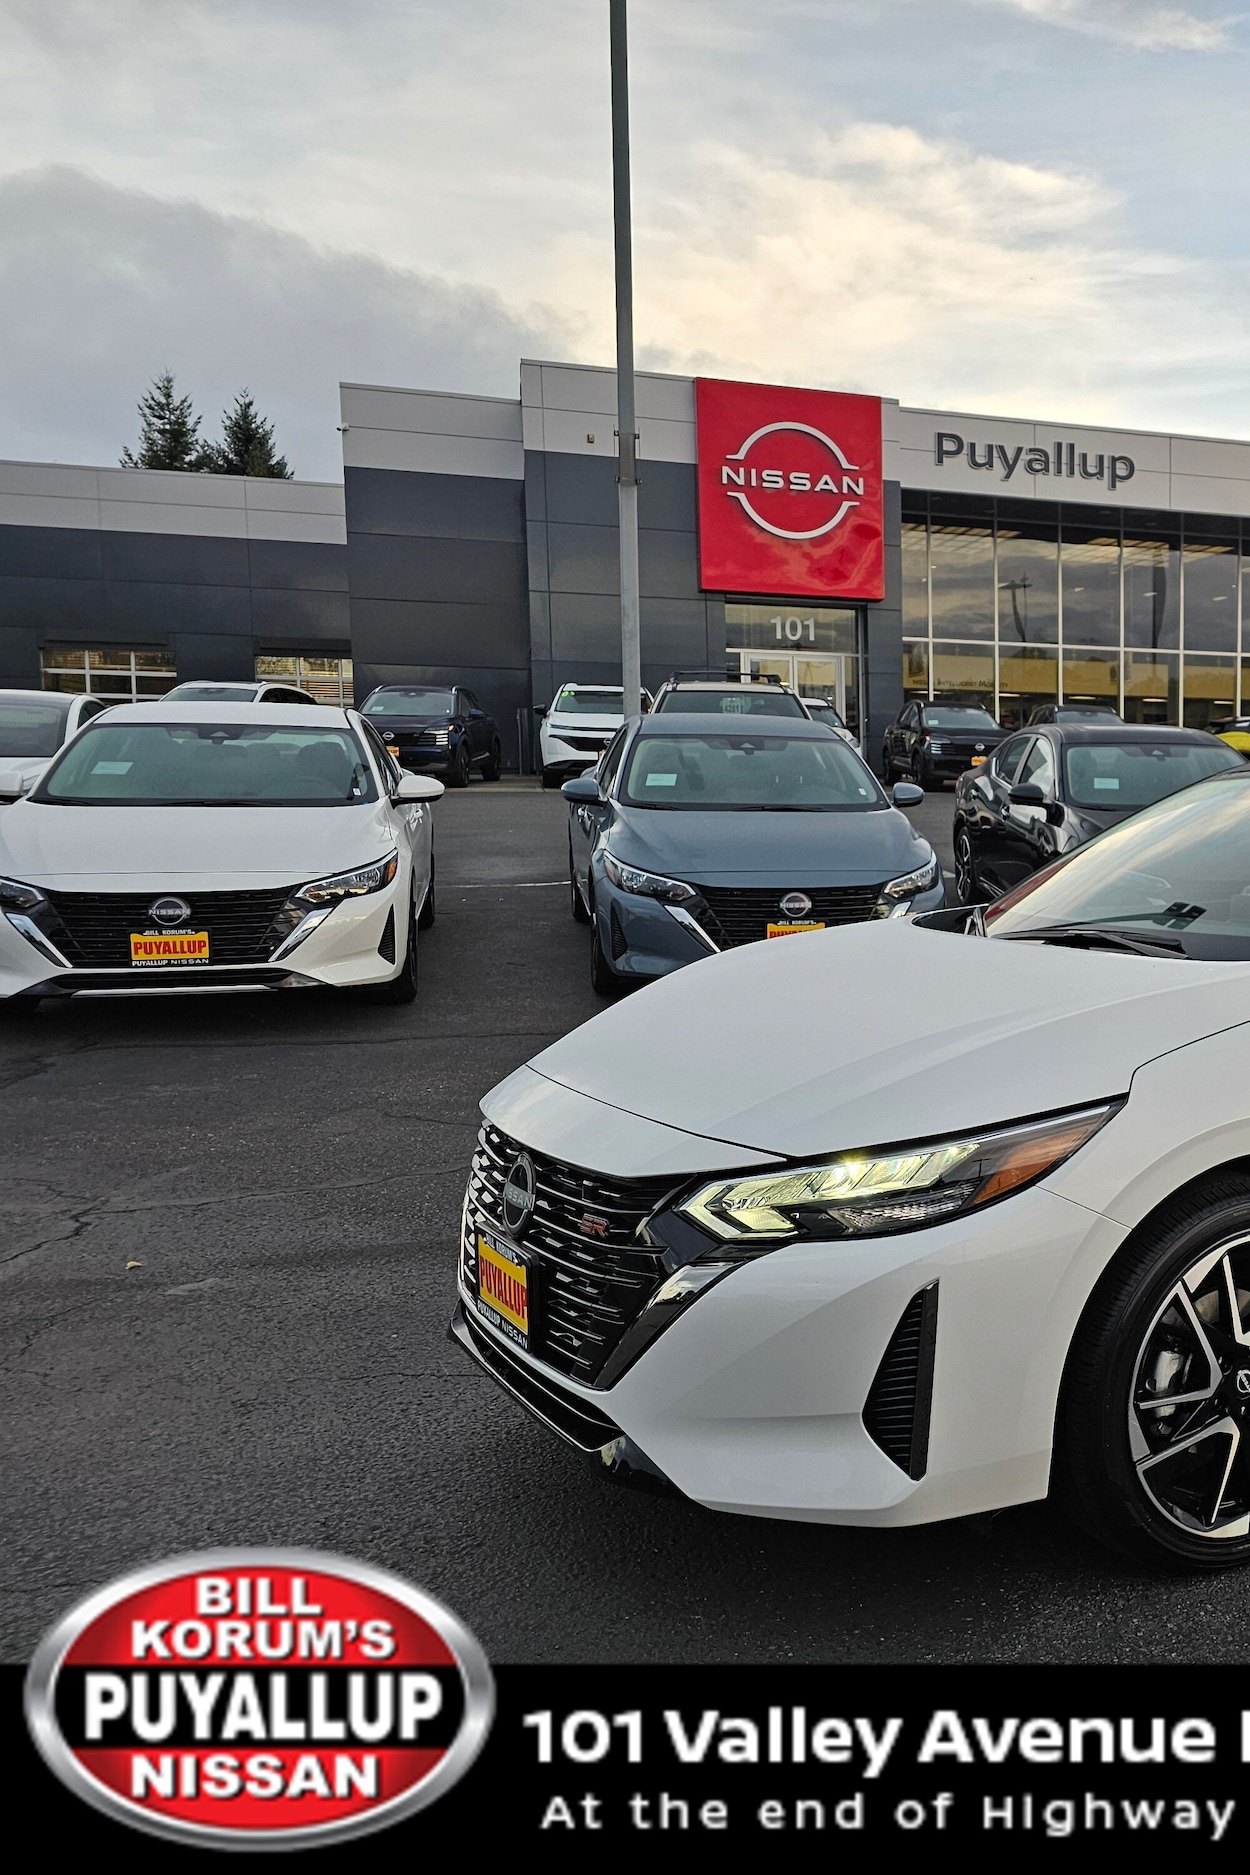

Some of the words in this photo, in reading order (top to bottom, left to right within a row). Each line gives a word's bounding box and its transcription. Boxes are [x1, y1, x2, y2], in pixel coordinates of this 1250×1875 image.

[935, 431, 1136, 491] Puyallup
[721, 465, 865, 496] NISSAN
[770, 615, 815, 641] 101
[148, 908, 191, 916] NISSAN
[133, 940, 207, 956] PUYALLUP
[131, 959, 168, 967] PUYALLUP
[580, 1213, 609, 1238] SR
[479, 1254, 528, 1319] PUYALLUP
[477, 1299, 501, 1326] PUYALLUP
[501, 1319, 528, 1350] NISSAN
